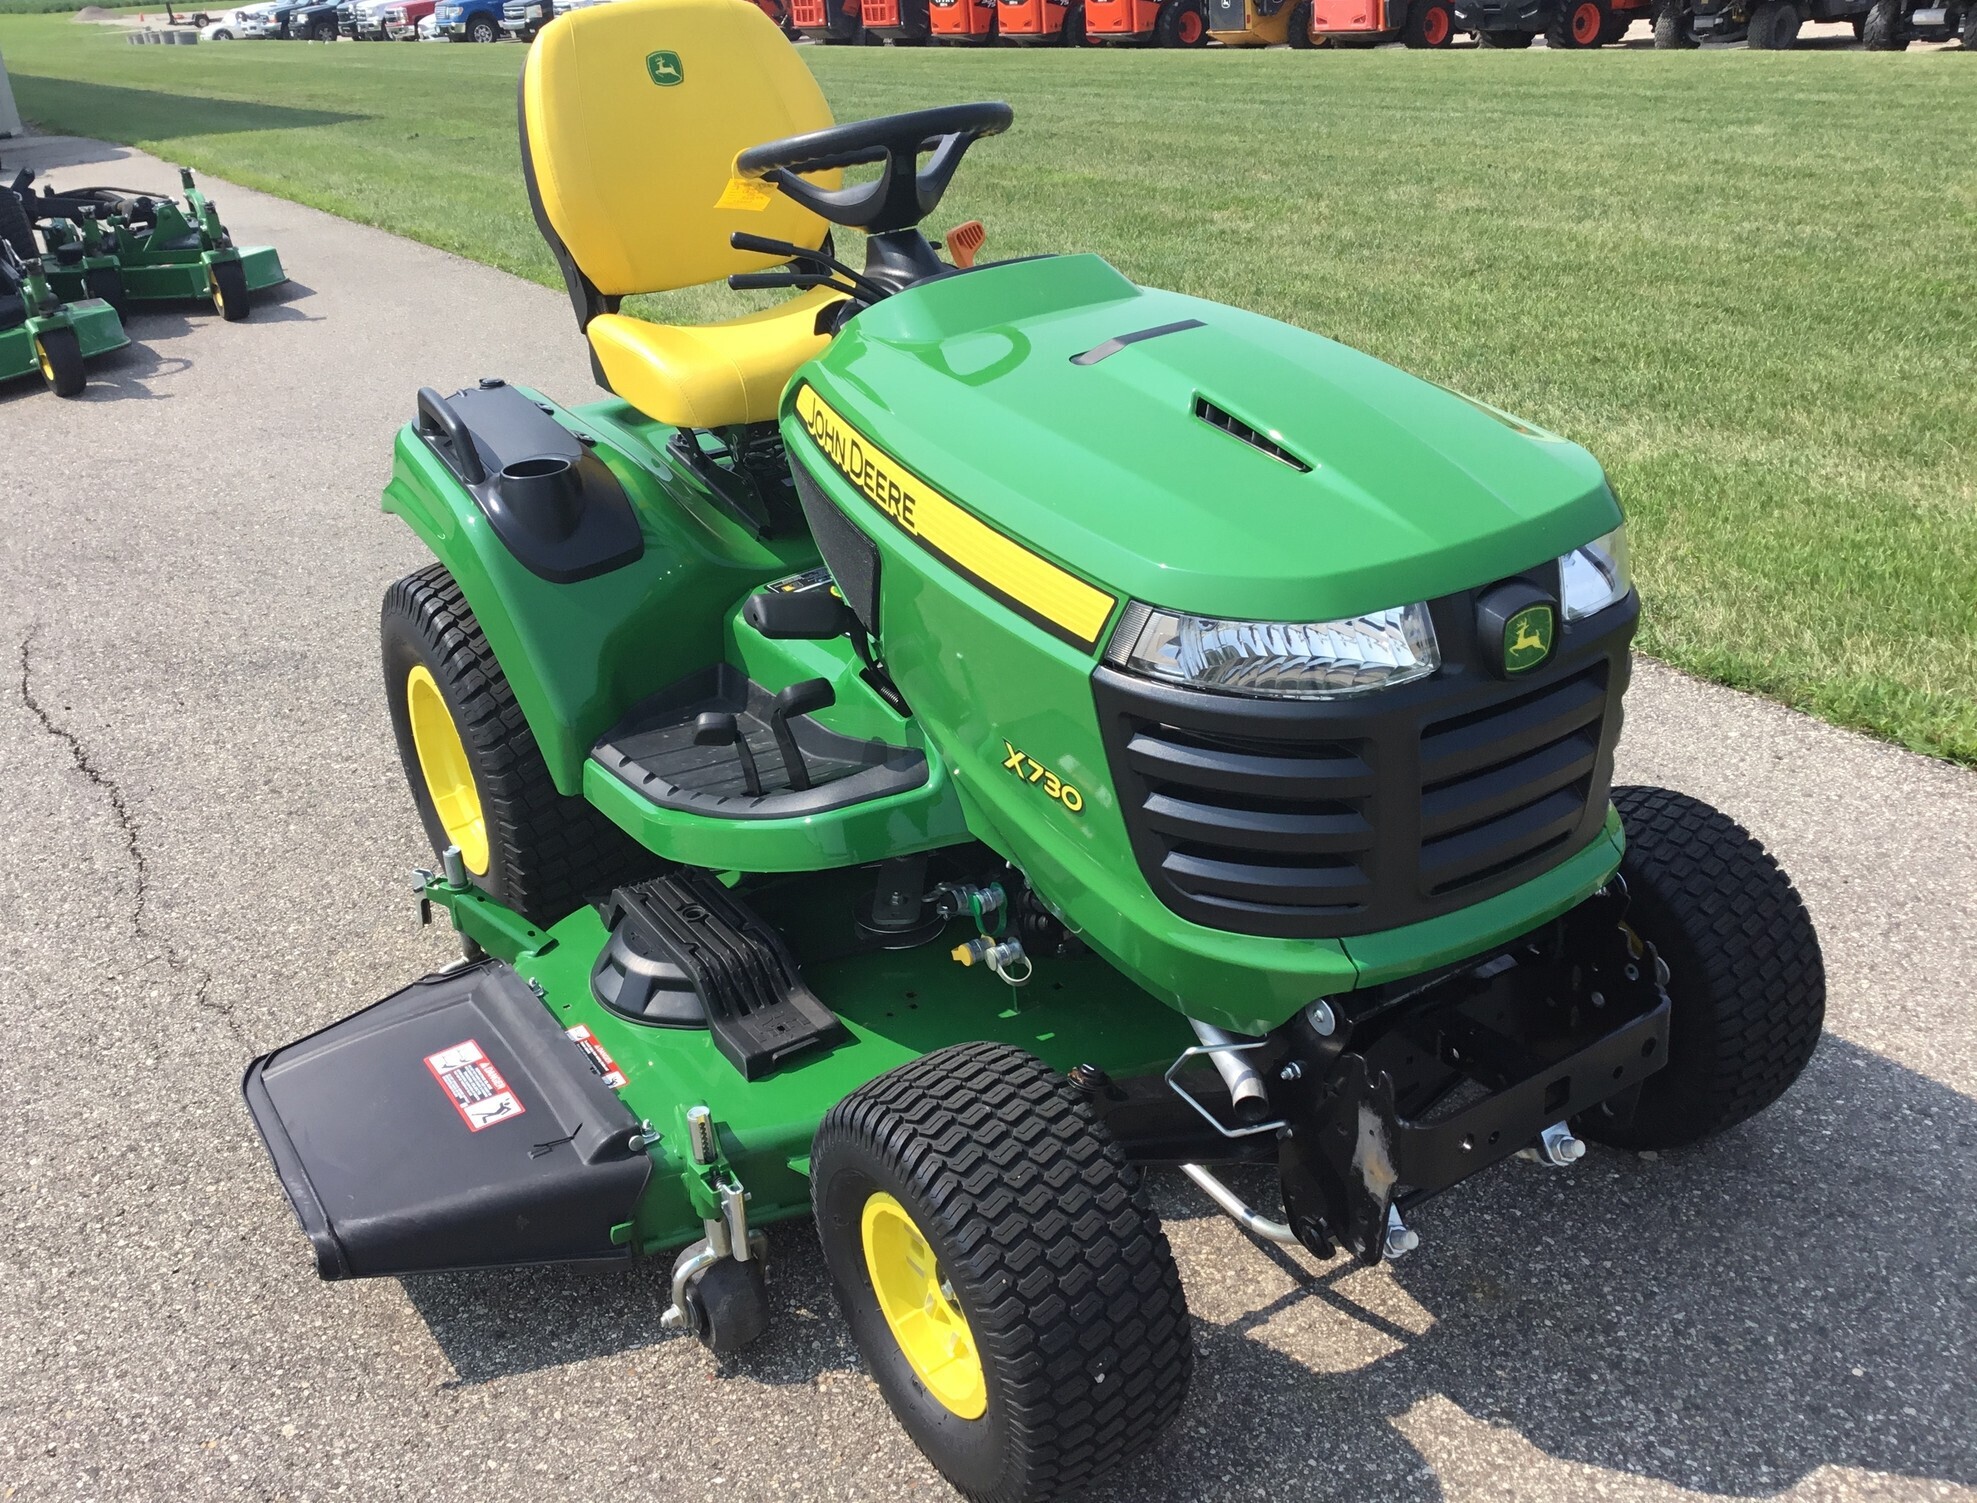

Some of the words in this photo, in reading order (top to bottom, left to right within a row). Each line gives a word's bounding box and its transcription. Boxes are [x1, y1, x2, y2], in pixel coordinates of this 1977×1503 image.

[807, 397, 846, 466] JOHN
[850, 438, 916, 529] DEERE
[1002, 739, 1083, 812] X730
[483, 1065, 507, 1090] DANGER
